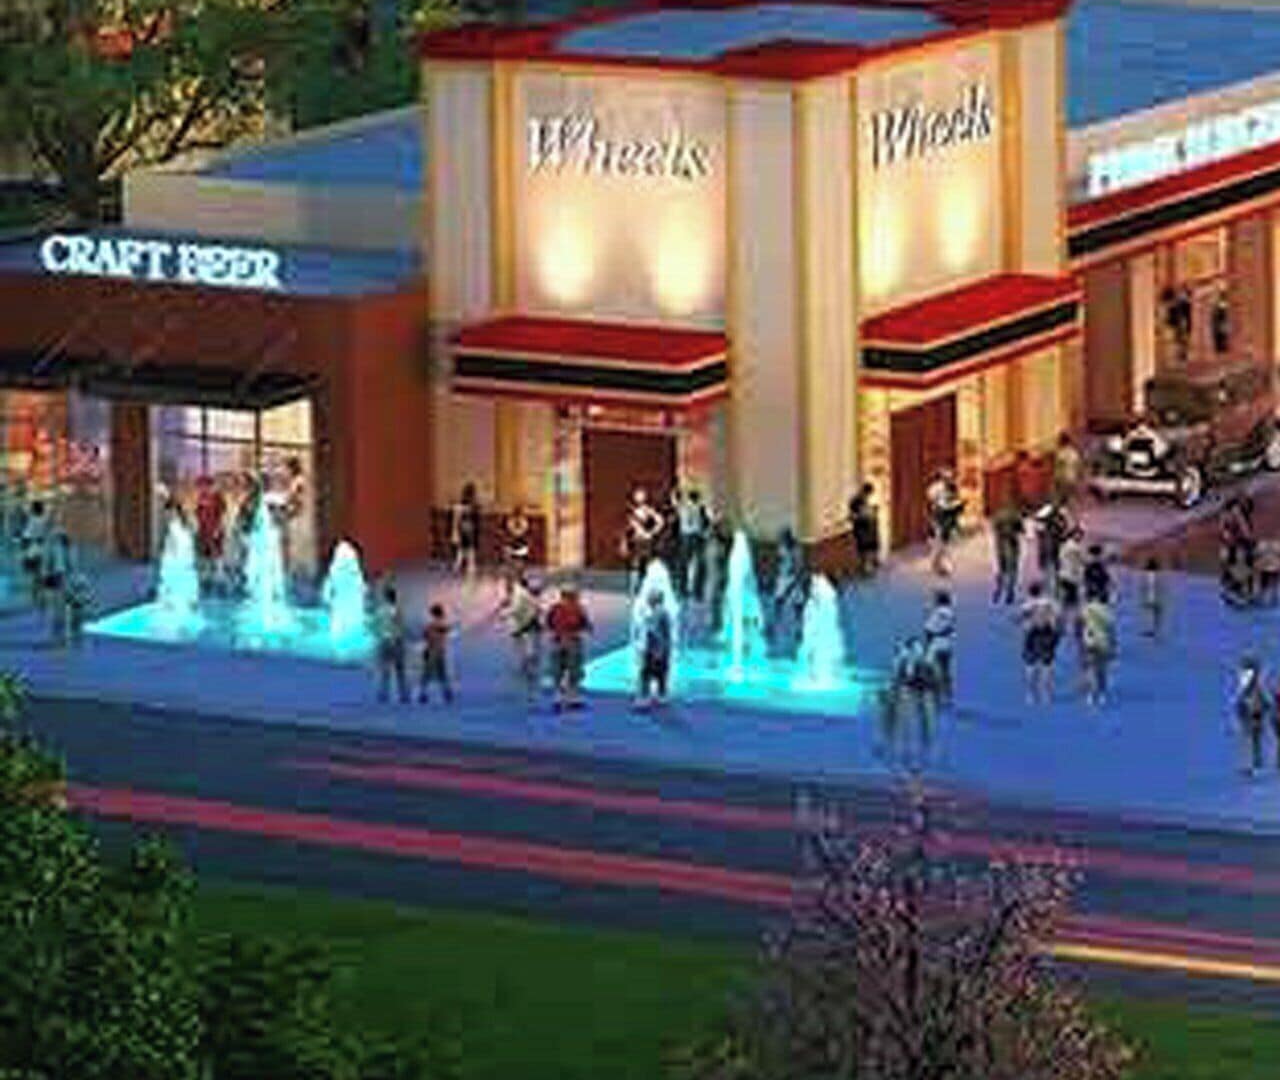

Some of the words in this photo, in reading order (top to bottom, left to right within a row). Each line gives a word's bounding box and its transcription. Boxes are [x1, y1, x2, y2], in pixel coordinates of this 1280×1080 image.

[527, 108, 716, 181] Wheels
[871, 84, 991, 170] Wheels
[41, 234, 171, 280] CRAFT
[177, 242, 281, 288] BEER
